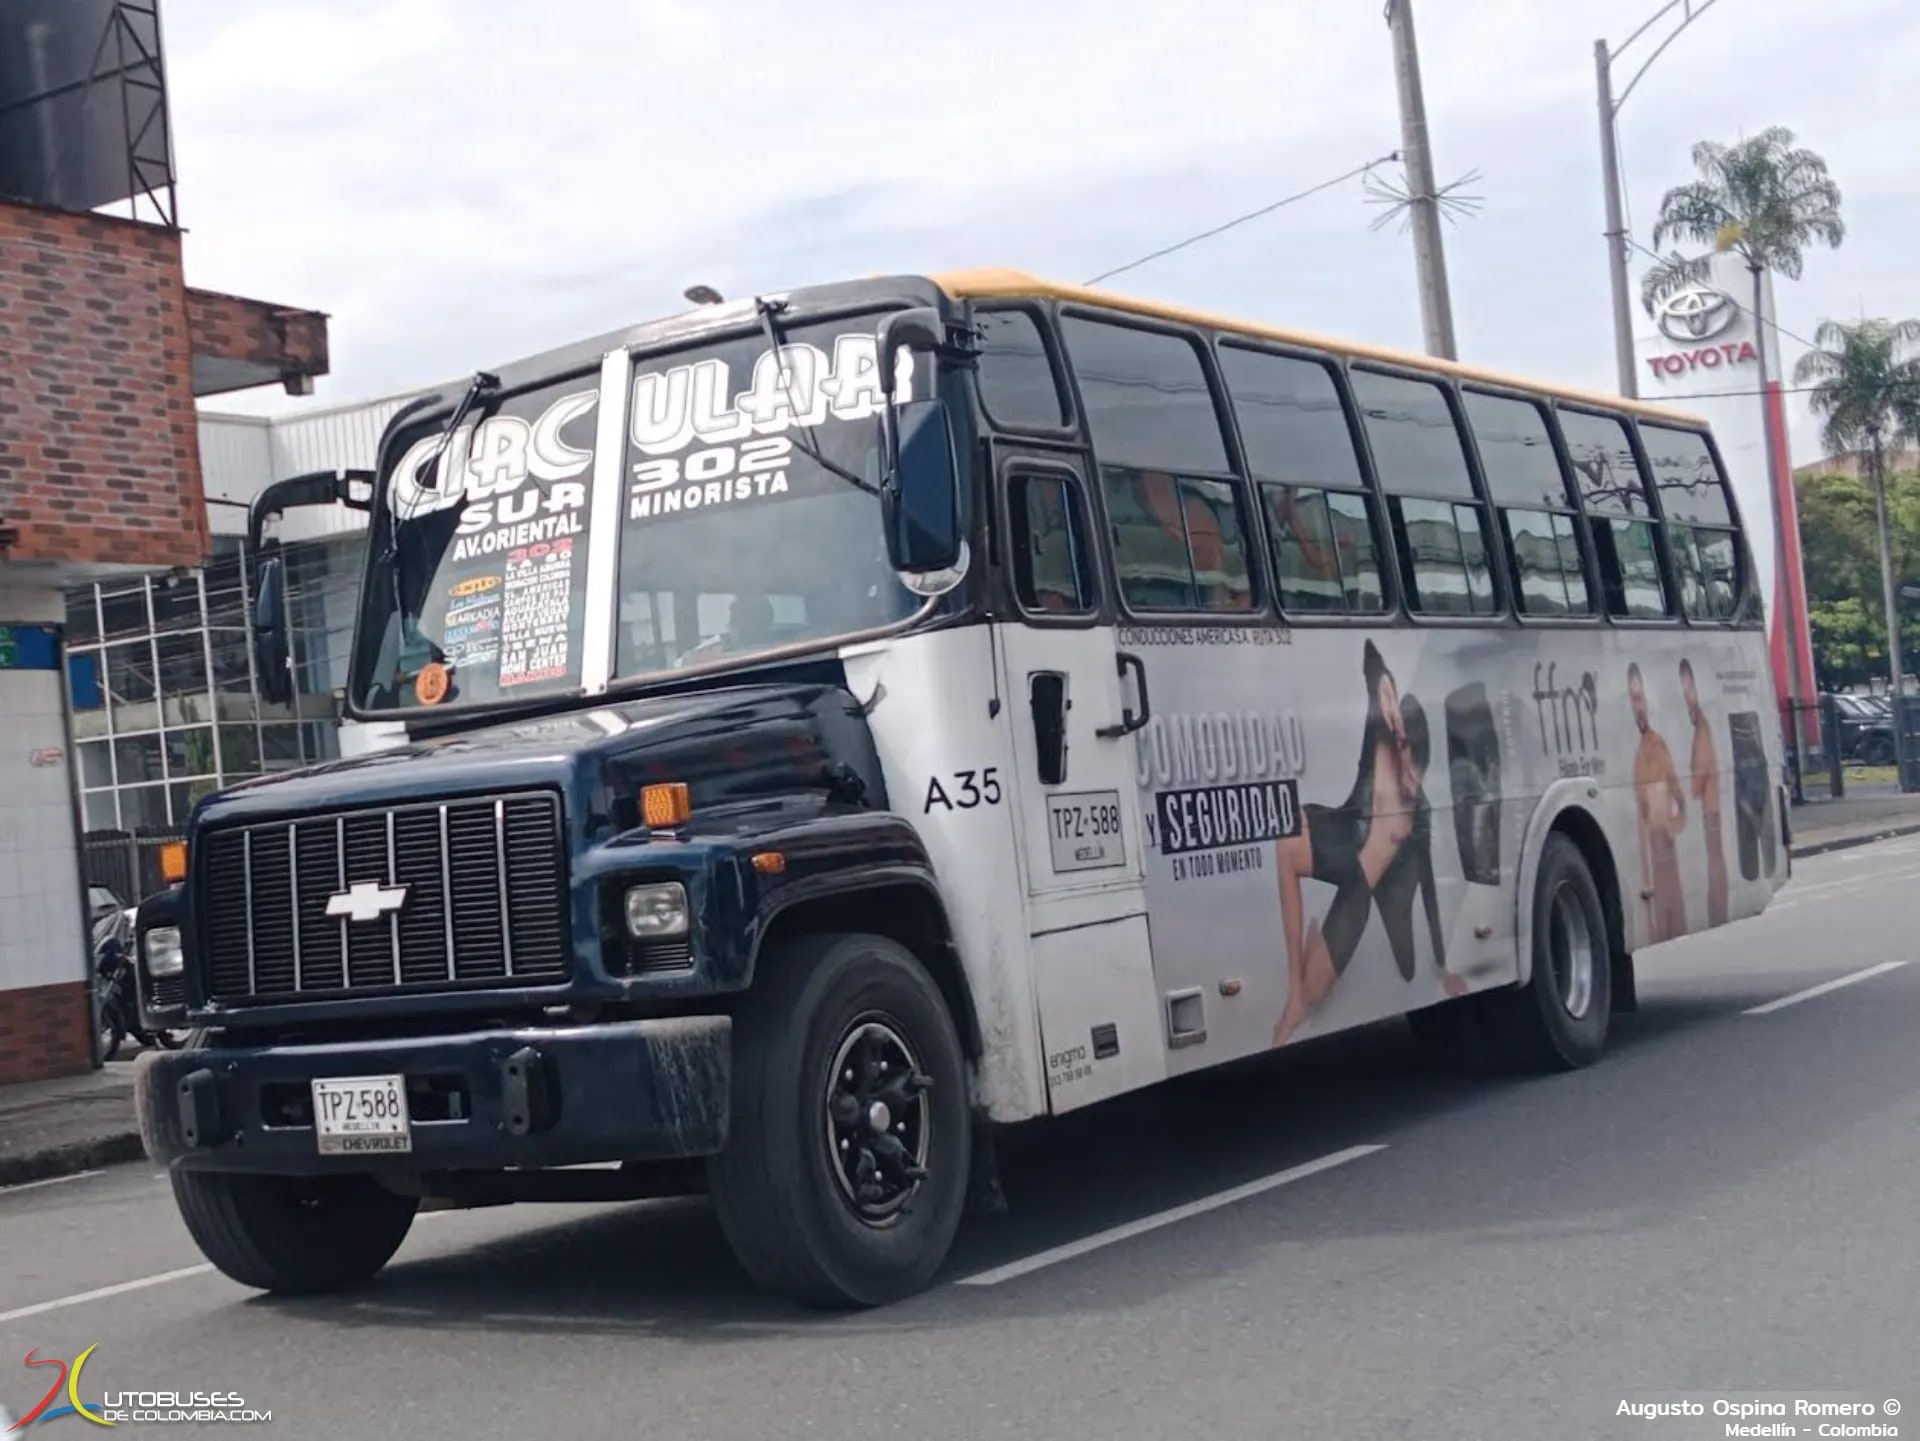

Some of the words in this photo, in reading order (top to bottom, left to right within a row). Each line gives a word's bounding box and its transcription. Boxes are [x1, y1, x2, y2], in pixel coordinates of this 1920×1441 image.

[1647, 341, 1757, 377] TOYOTA
[632, 437, 793, 494] 302
[455, 483, 586, 534] SUR
[630, 470, 789, 519] MINORISTA
[1135, 709, 1306, 788] COMODIDAD
[924, 767, 1001, 814] A35
[1146, 813, 1156, 848] Y
[1165, 783, 1295, 850] SEGURIDAD
[1172, 858, 1187, 881] EN
[1189, 853, 1214, 878] TODO
[1216, 846, 1263, 874] MOMENTO
[342, 1136, 407, 1151] CHEVROLET
